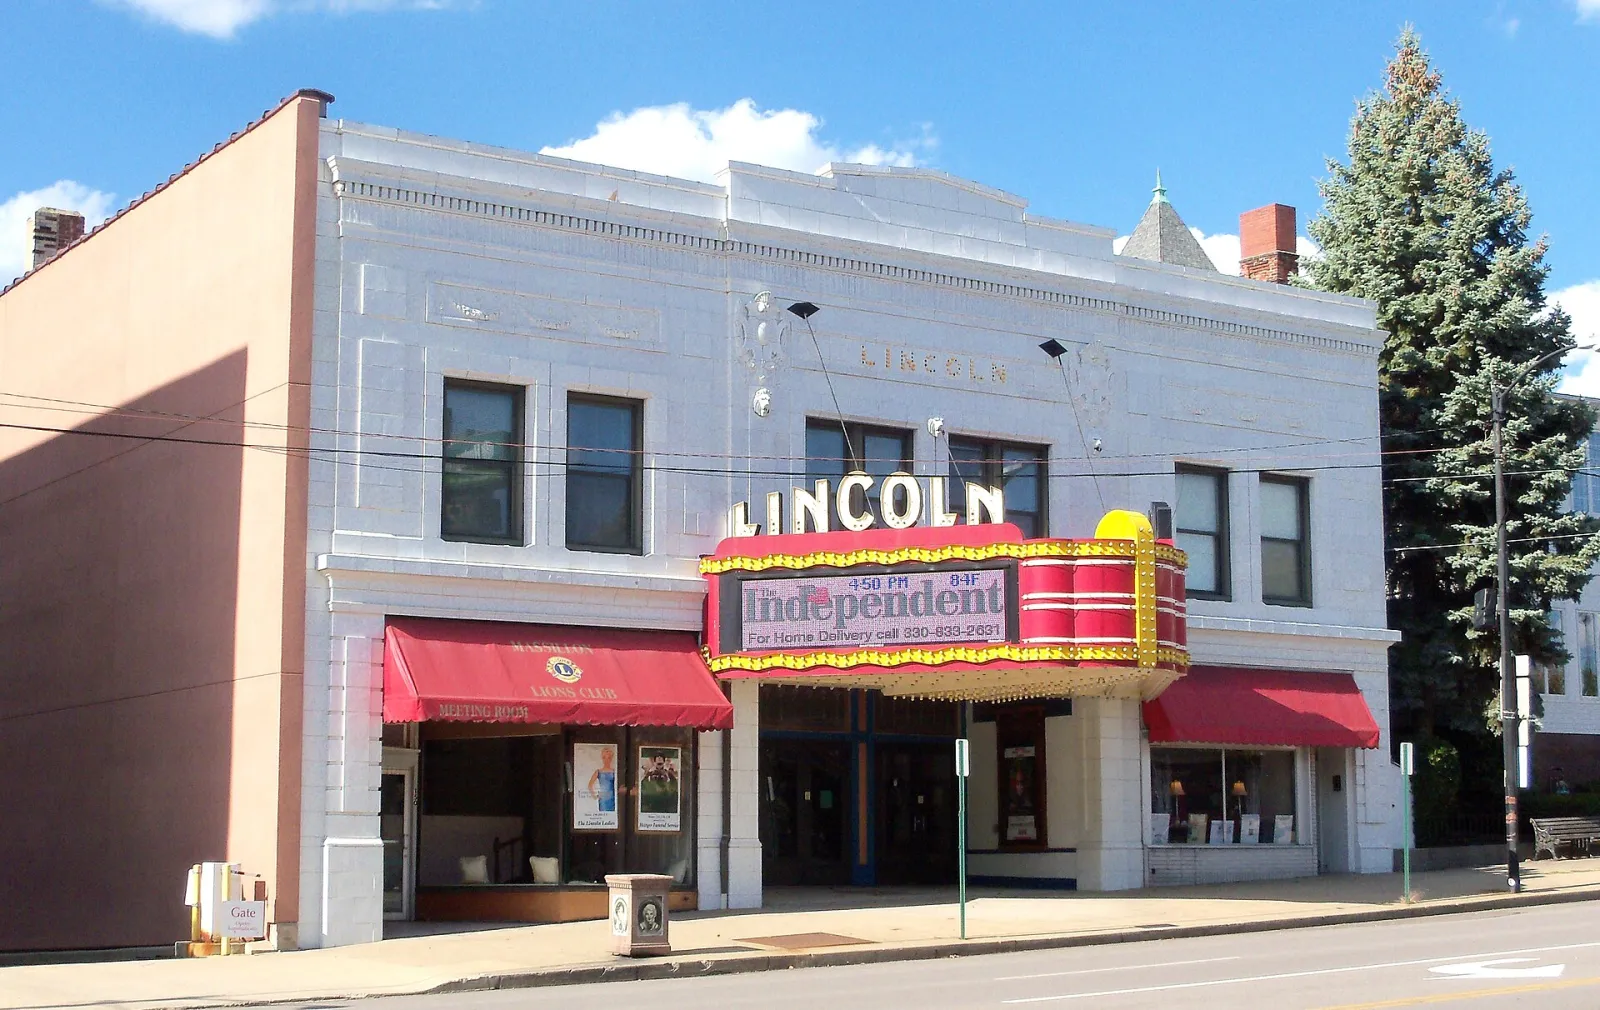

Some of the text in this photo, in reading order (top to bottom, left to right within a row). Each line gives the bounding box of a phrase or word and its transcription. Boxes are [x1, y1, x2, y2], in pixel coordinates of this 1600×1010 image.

[861, 344, 1006, 383] LINCOLN
[731, 470, 1004, 537] LINCOLN
[848, 576, 909, 591] 4:50 PM
[950, 573, 980, 587] 84F
[761, 588, 777, 598] The
[743, 578, 1004, 630] Independent
[748, 631, 771, 644] For
[774, 632, 814, 643] Home
[819, 629, 873, 643] Delivery
[876, 628, 899, 640] call
[510, 640, 594, 656] MASSILLON
[530, 686, 618, 699] LIONS CLUB
[439, 703, 529, 719] MEETING ROOM
[231, 906, 256, 918] Gate
